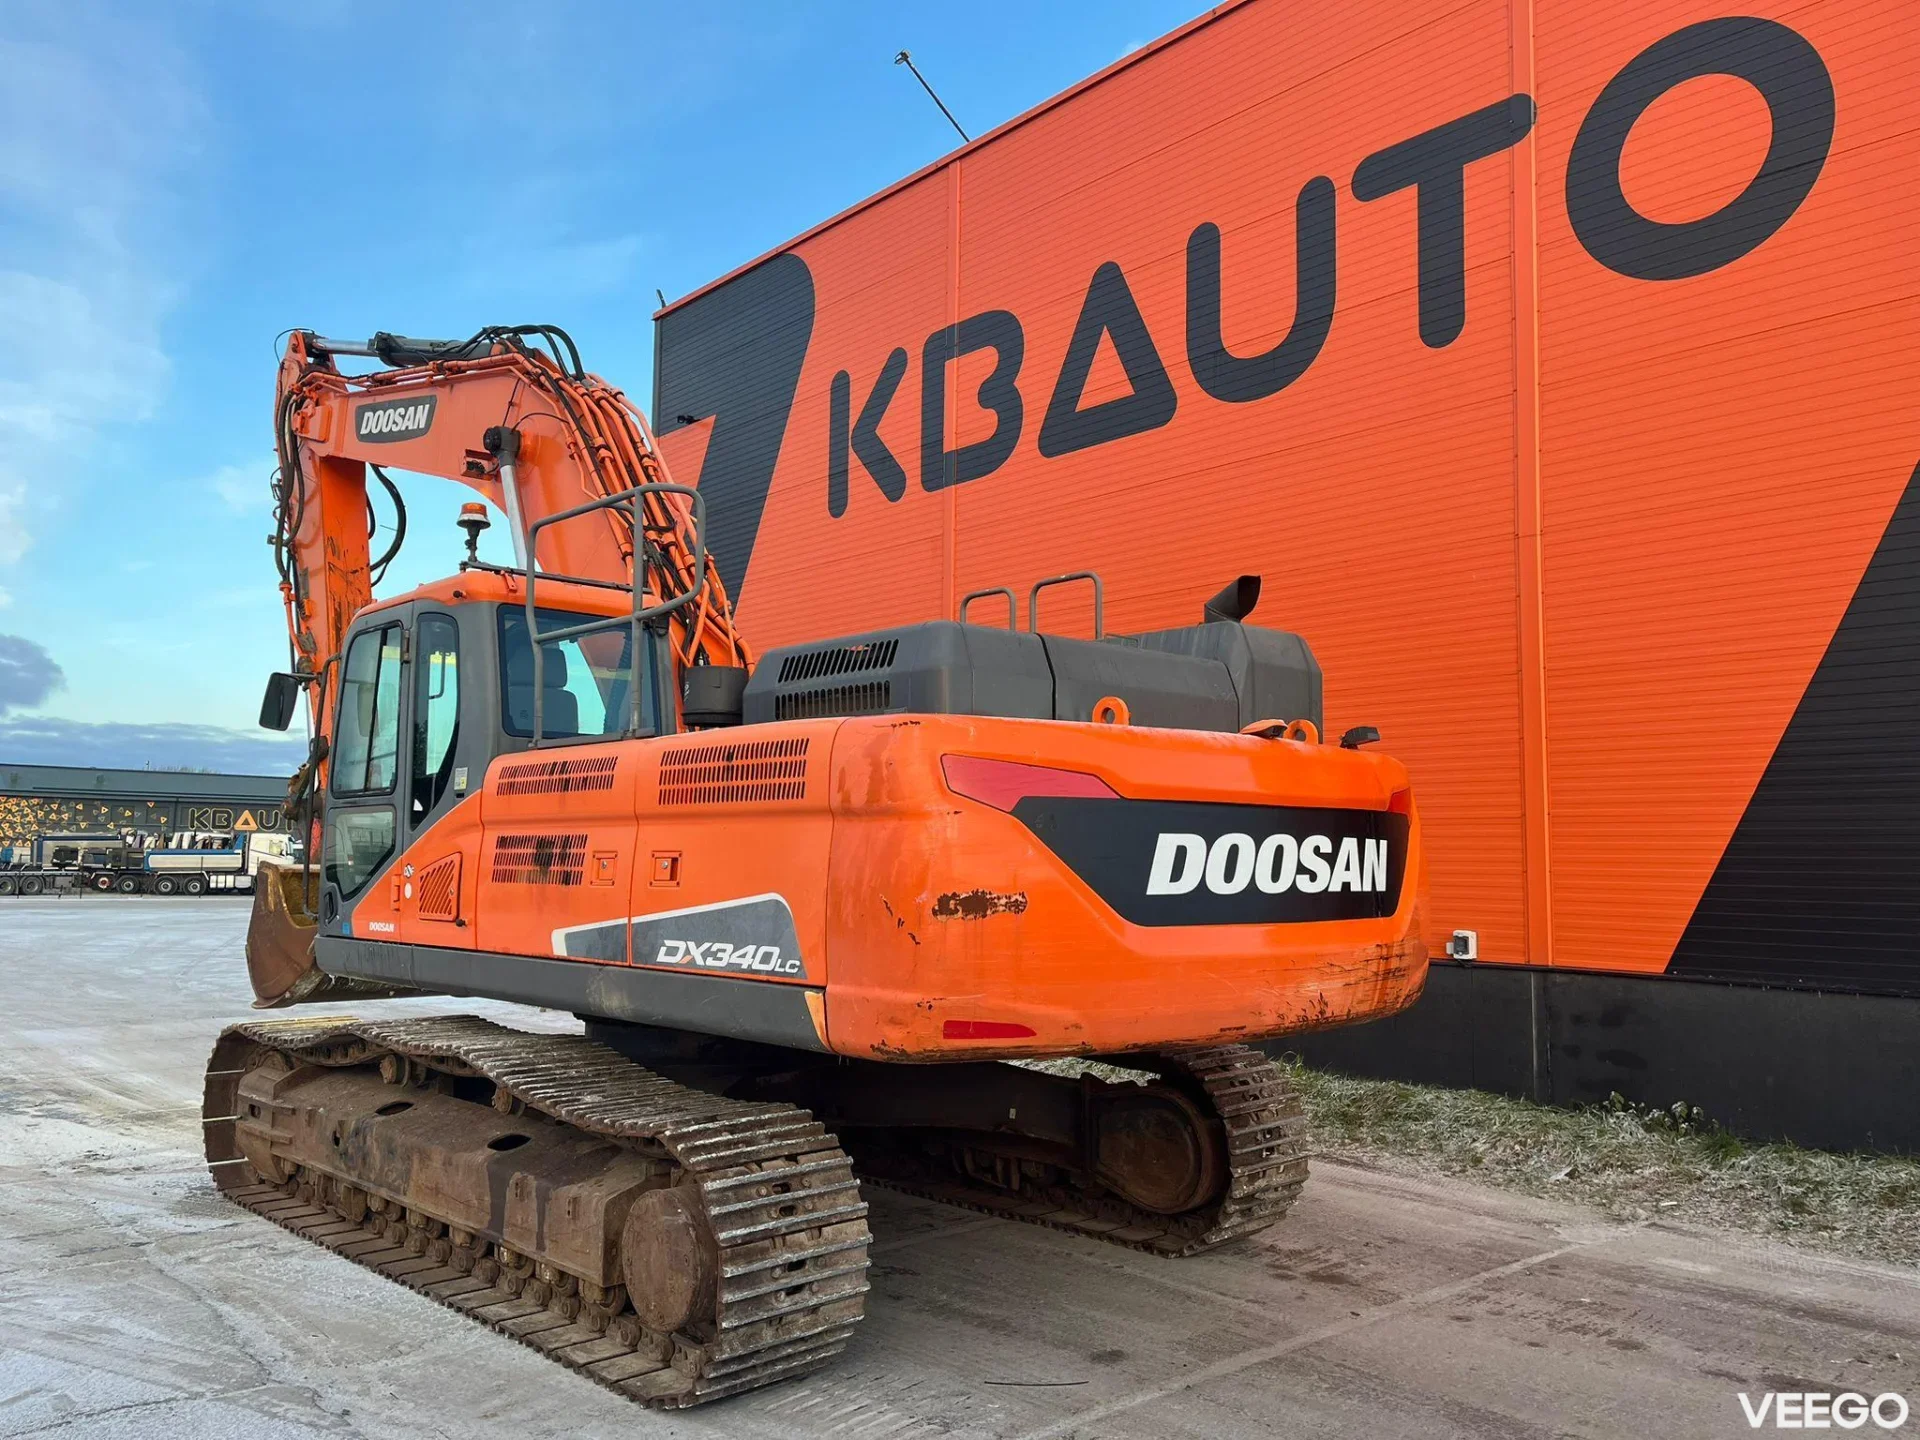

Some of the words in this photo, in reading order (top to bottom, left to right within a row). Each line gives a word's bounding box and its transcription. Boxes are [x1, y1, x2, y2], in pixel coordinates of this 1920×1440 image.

[828, 15, 1836, 519] KBAUTO
[360, 404, 430, 435] DOOSAN
[1146, 832, 1388, 896] DOOSAN
[369, 921, 395, 933] DOOSAN
[656, 939, 801, 974] DX340LC
